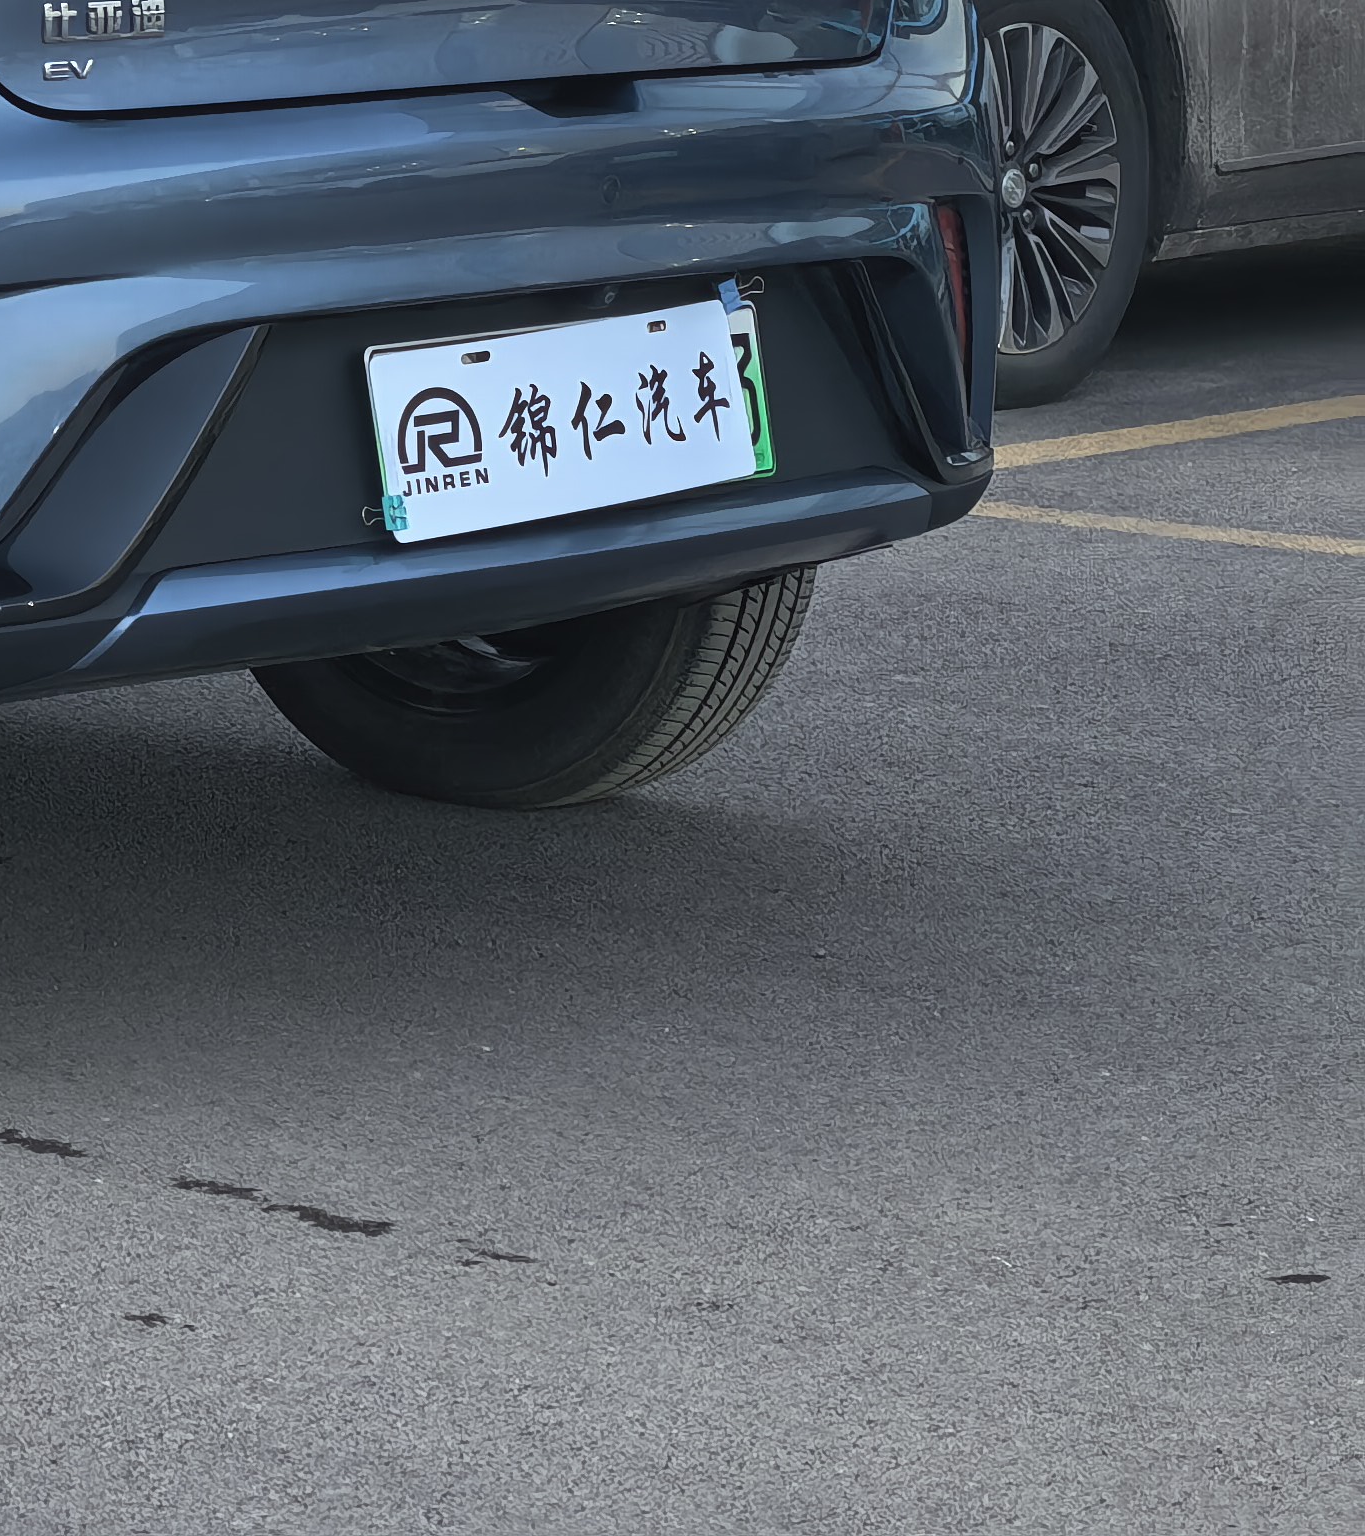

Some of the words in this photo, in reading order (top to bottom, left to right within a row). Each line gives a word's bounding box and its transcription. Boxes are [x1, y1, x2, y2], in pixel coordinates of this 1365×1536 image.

[43, 59, 93, 80] EV
[498, 351, 731, 478] 锦仁汽车
[402, 467, 490, 498] JINREN
